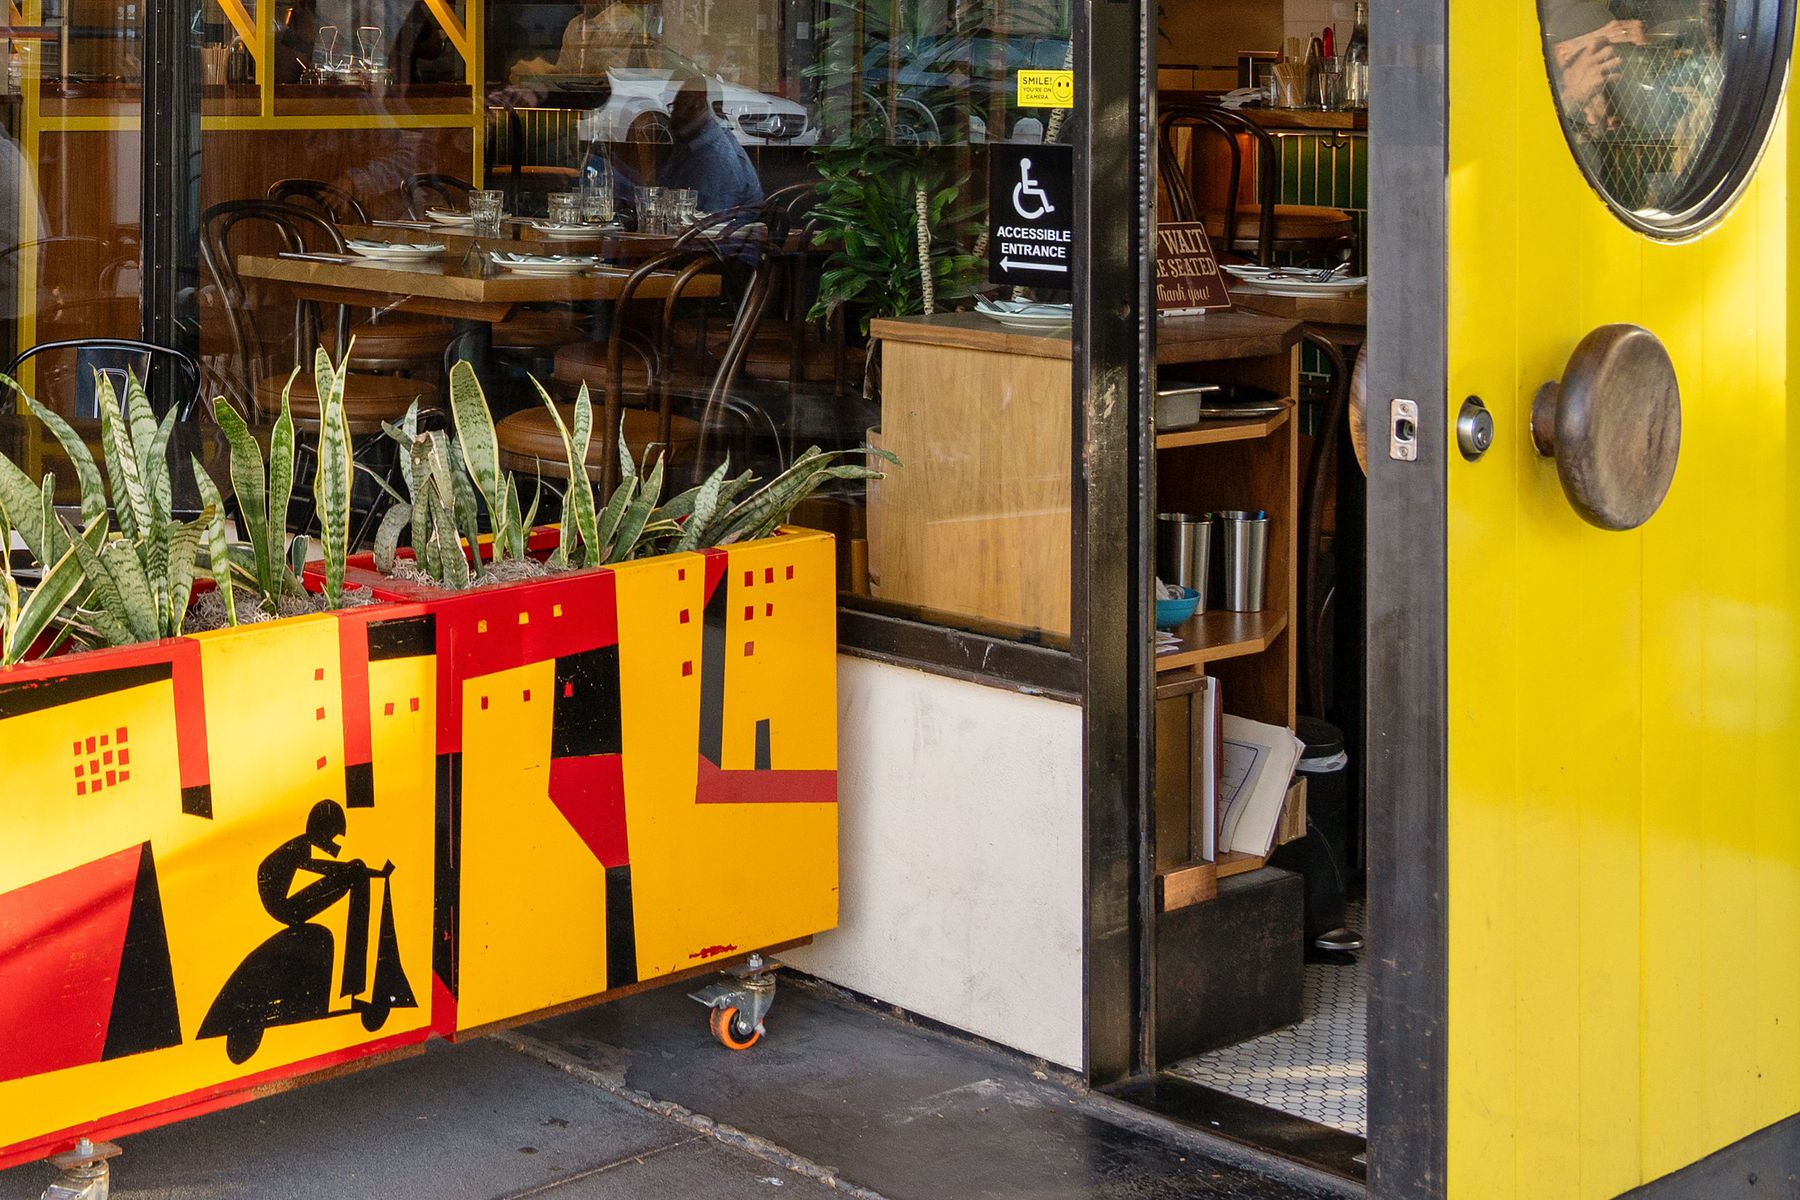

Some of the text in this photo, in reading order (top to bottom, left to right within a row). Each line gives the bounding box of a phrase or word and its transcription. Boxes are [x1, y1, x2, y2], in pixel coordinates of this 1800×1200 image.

[1022, 76, 1053, 86] SMILE!
[996, 225, 1072, 242] ACCESSIBLE
[1158, 228, 1207, 255] WAIT
[1001, 242, 1067, 259] ENTRANCE
[1167, 257, 1217, 278] SEATED
[1187, 286, 1211, 307] you!
